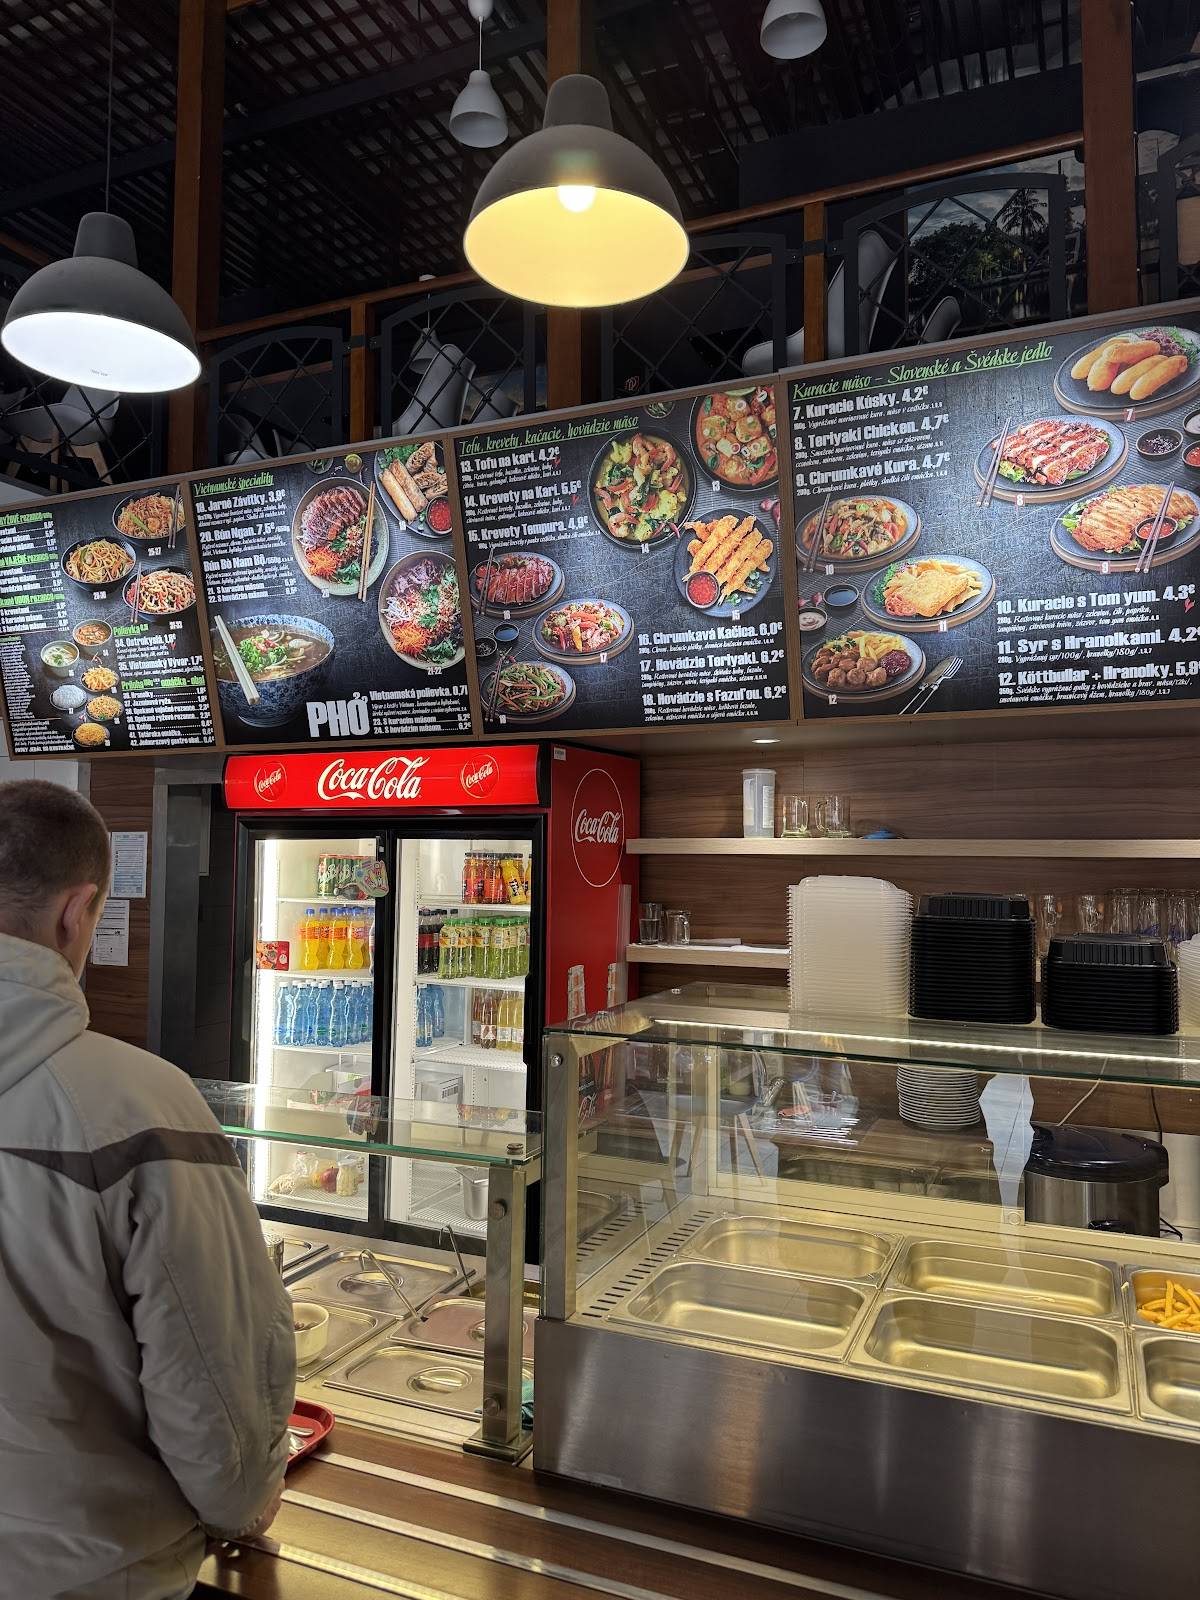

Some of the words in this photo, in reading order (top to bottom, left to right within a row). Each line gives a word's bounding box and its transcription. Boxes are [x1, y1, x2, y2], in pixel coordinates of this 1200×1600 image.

[793, 380, 839, 400] Kuracie
[842, 376, 871, 391] mäso
[888, 358, 949, 384] Slovenské
[951, 362, 961, 372] a
[965, 348, 1017, 371] Švédske
[1018, 341, 1053, 366] jedlo
[793, 407, 805, 420] 7.
[806, 399, 854, 418] Kuracie
[856, 391, 899, 410] Kúsky.
[902, 385, 929, 403] 4,2€
[1126, 409, 1133, 421] 7
[460, 437, 484, 456] Tofu,
[486, 431, 522, 450] krevety,
[524, 427, 564, 446] kačacie,
[567, 419, 610, 440] hovädzie
[612, 415, 638, 430] mäso
[794, 436, 806, 450] 8.
[808, 427, 862, 449] Teriyaki
[863, 421, 919, 440] Chicken.
[921, 413, 949, 431] 4,7€
[460, 460, 474, 474] 13.
[475, 455, 497, 471] Tofu
[498, 454, 511, 468] na
[512, 450, 536, 466] kari.
[538, 446, 560, 461] 4,2€
[796, 473, 808, 487] 9.
[809, 462, 883, 485] Chrumkavé
[884, 459, 921, 475] Kura.
[922, 452, 951, 469] 4,7€
[194, 477, 236, 496] Vietnamské
[238, 472, 273, 490] špeciality
[464, 494, 478, 508] 14.
[479, 487, 520, 506] Krevety
[521, 486, 535, 501] na
[535, 482, 560, 499] Kari.
[712, 480, 720, 492] 13
[208, 498, 233, 512] Jarné
[232, 492, 269, 508] Závitky.
[1016, 495, 1024, 506] 8
[200, 531, 214, 544] 20.
[231, 526, 257, 538] Ngan.
[467, 529, 481, 544] 15.
[481, 524, 521, 543] Krevety
[521, 519, 567, 536] Tempura.
[640, 543, 649, 554] 14
[232, 557, 253, 569] Nam
[826, 565, 835, 576] 10
[1101, 562, 1109, 573] 9
[997, 601, 1015, 614] 10.
[1017, 595, 1076, 613] Kuracie
[1077, 596, 1087, 609] s
[1088, 591, 1121, 608] Tom
[1122, 587, 1159, 607] yum.
[1162, 583, 1196, 602] 4,3€
[731, 609, 740, 621] 15
[638, 633, 653, 646] 16.
[653, 628, 717, 645] Chrumkavá
[717, 625, 759, 641] Kačica.
[998, 641, 1015, 654] 11.
[1017, 638, 1048, 656] Syr
[1051, 638, 1061, 651] s
[1064, 629, 1165, 650] Hranolkami.
[640, 660, 655, 672] 17.
[656, 655, 706, 671] Hovädzie
[707, 651, 759, 669] Teriyaki.
[761, 649, 785, 664] 6,2€
[998, 672, 1016, 686] 12.
[1017, 668, 1089, 685] Köttbullar
[1091, 673, 1101, 681] +
[1103, 663, 1173, 680] Hranolky.
[369, 689, 416, 701] Vietnamská
[416, 686, 452, 700] polievka.
[642, 694, 657, 706] 18.
[657, 690, 706, 706] Hovädzie
[706, 691, 714, 703] s
[764, 685, 788, 700] 6,2€
[829, 694, 838, 705] 12
[373, 718, 383, 726] 23.
[257, 770, 282, 793] Coca-Cola
[317, 756, 430, 802] Coca-Cola
[465, 767, 494, 791] Coca-Cola
[574, 811, 622, 846] Coca-Cola
